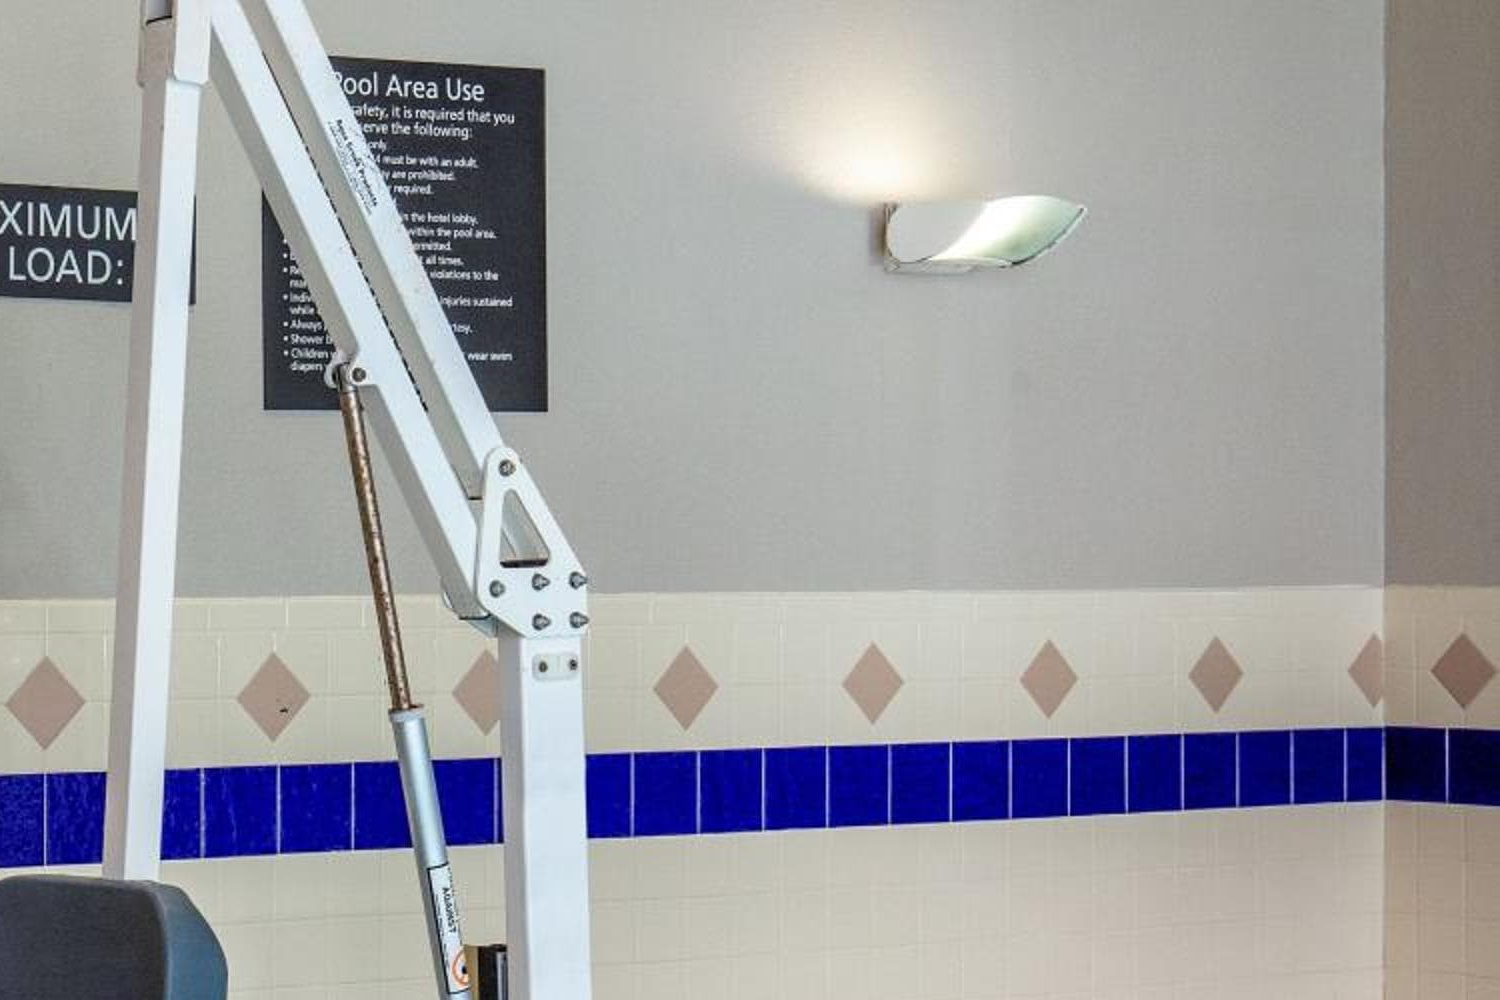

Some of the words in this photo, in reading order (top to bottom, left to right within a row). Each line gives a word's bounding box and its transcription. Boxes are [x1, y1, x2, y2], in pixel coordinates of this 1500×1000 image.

[385, 74, 438, 99] Area
[446, 77, 485, 102] Use
[392, 104, 400, 118] it
[404, 106, 412, 118] is
[415, 107, 464, 124] required
[467, 110, 491, 123] that
[493, 113, 515, 126] you
[391, 123, 411, 135] the
[413, 123, 473, 141] following:
[382, 155, 404, 165] must
[406, 154, 417, 165] be
[420, 155, 439, 166] with
[441, 158, 452, 167] an
[391, 171, 406, 179] are
[410, 213, 426, 222] the
[427, 211, 451, 223] hotel
[436, 228, 452, 237] the
[453, 228, 473, 239] pool
[9, 246, 124, 285] LOAD:
[429, 270, 470, 280] violations
[472, 270, 483, 280] to
[484, 269, 499, 281] the
[473, 296, 513, 307] sustained
[290, 319, 322, 332] Always
[291, 333, 324, 345] Shower
[291, 348, 328, 359] Children
